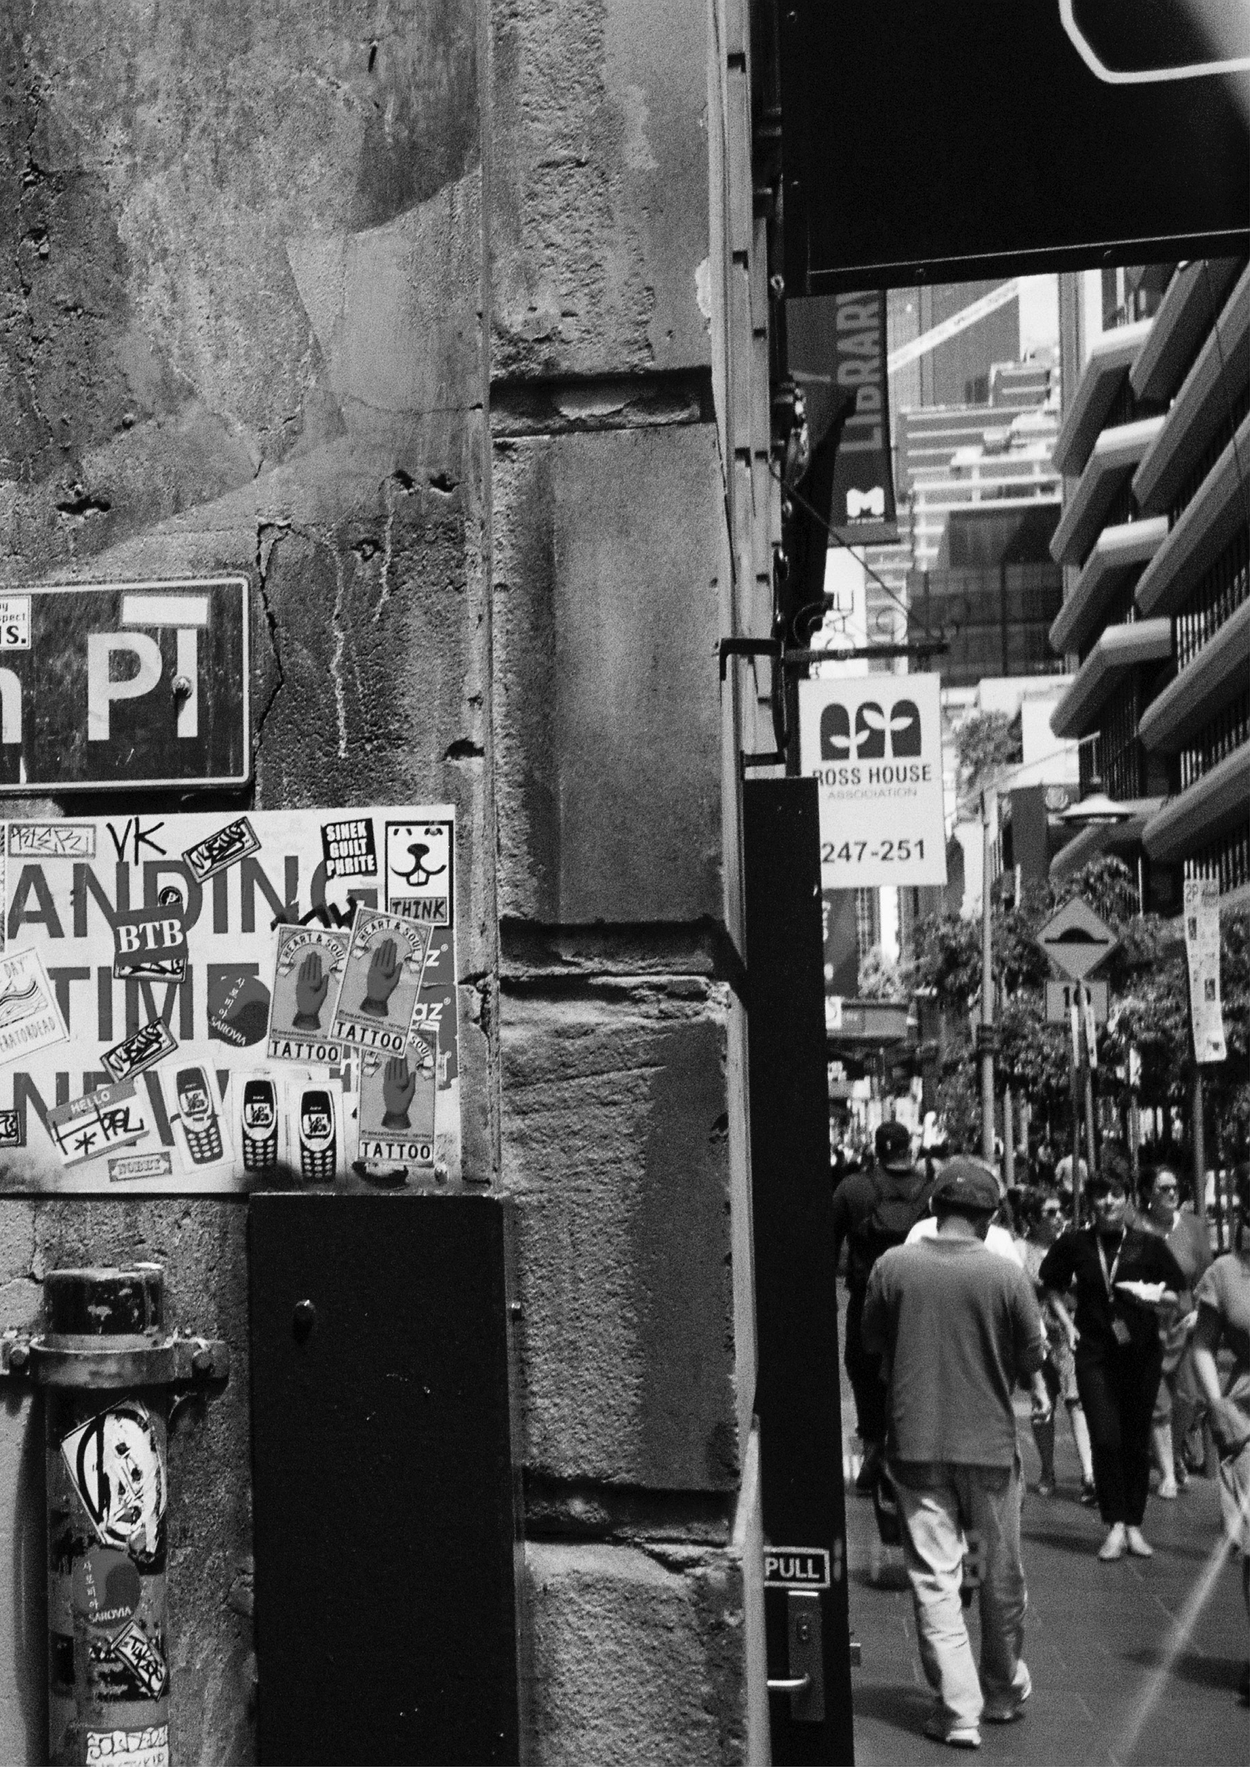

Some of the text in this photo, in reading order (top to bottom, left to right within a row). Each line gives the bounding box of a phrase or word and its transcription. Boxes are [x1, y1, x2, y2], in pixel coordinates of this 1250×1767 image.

[87, 627, 198, 742] Pl
[812, 764, 932, 787] ROSS HOUSE
[330, 838, 368, 859] GUILT
[822, 838, 925, 864] 247-251
[392, 901, 445, 919] THINK
[117, 918, 184, 953] BTB
[360, 920, 391, 942] HEART
[284, 933, 313, 959] HEART
[336, 1021, 403, 1051] TATTOO
[272, 1040, 339, 1062] TATTOO
[70, 1090, 110, 1115] HELLO
[361, 1142, 432, 1160] TATTOO
[765, 1556, 821, 1579] PULL
